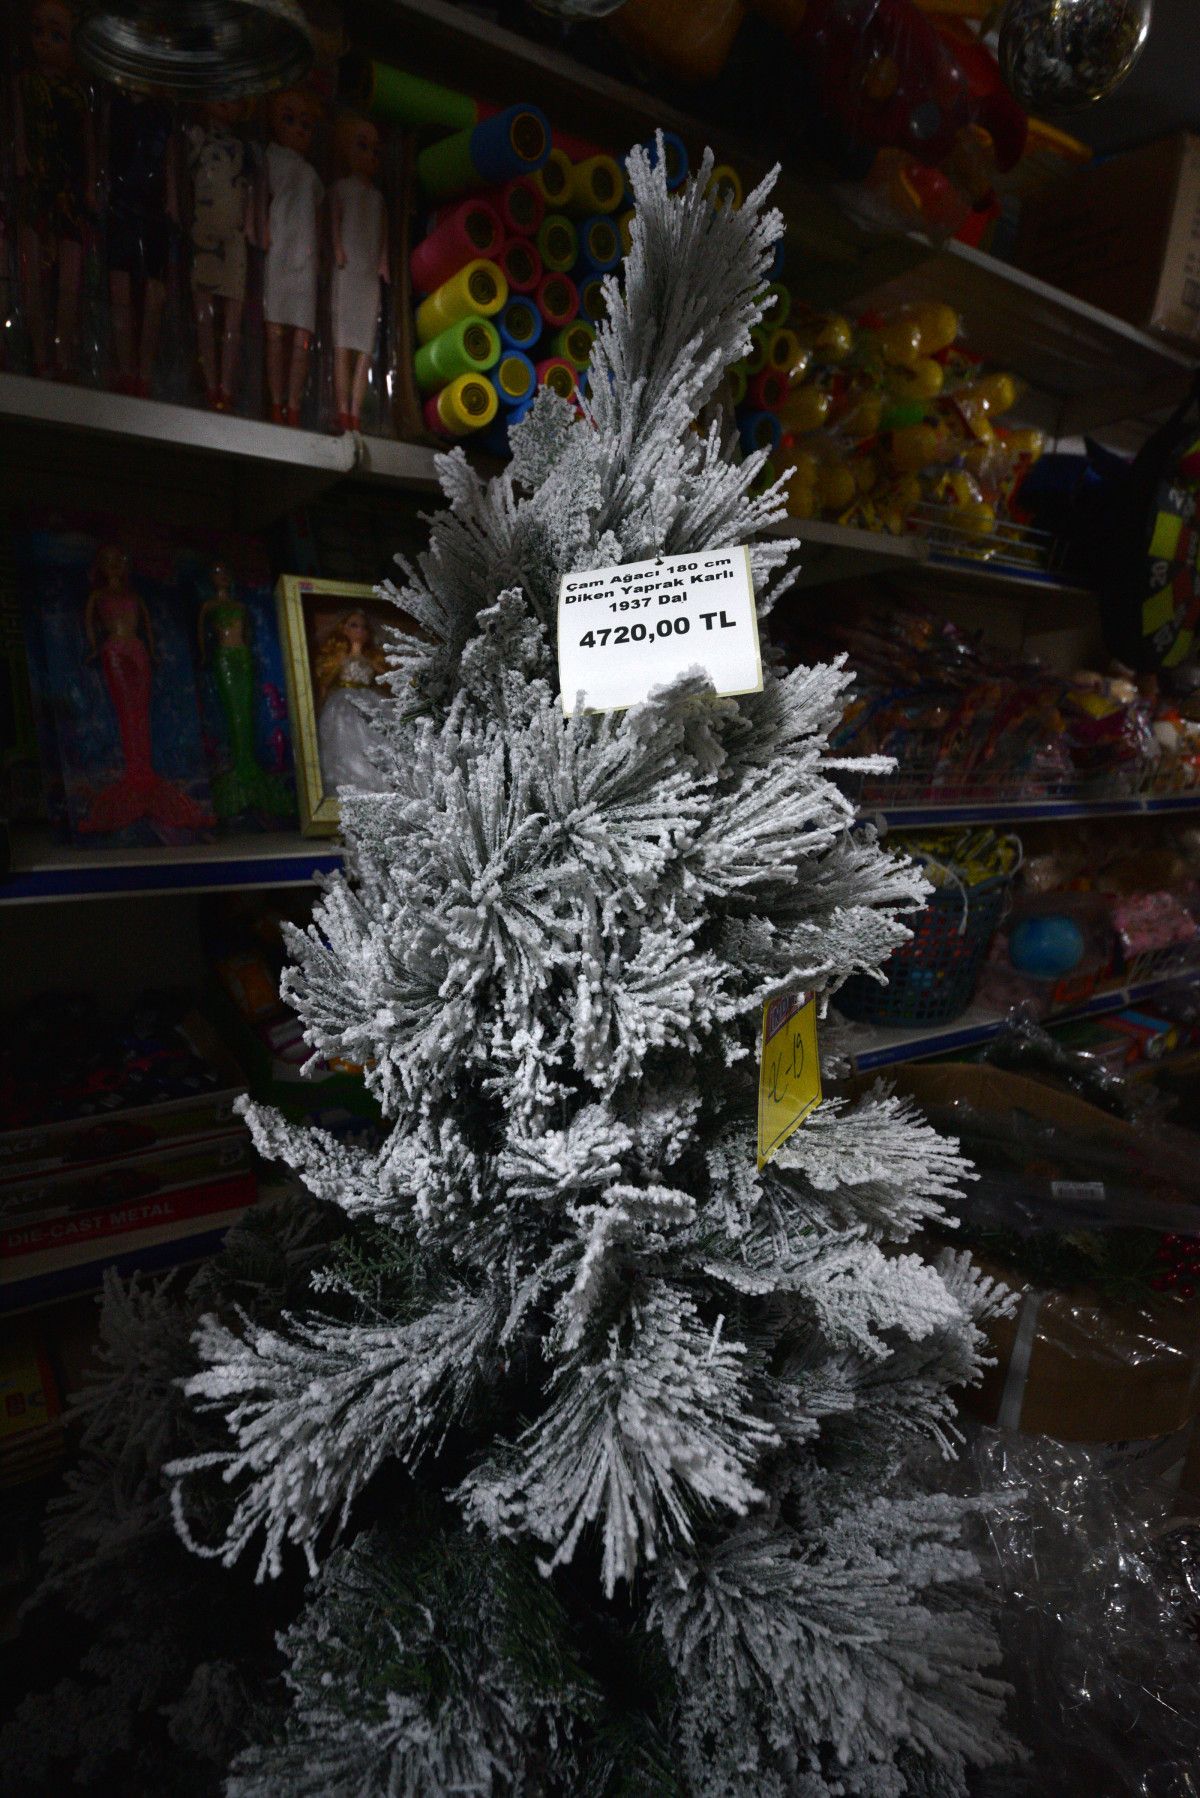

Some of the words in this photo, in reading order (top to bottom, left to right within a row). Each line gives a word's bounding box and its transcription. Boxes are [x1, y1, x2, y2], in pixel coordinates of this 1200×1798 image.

[565, 590, 615, 605] Diken
[621, 578, 684, 596] Yaprak
[691, 570, 734, 584] Karlı
[566, 578, 604, 592] Çam
[610, 570, 660, 584] Ağacı
[667, 562, 698, 574] 180
[704, 557, 732, 568] cm
[609, 598, 652, 612] 1937
[658, 591, 688, 606] Dal
[579, 616, 691, 649] 4720,00
[699, 610, 737, 631] TL
[7, 1214, 103, 1248] DIE-CAST
[109, 1202, 175, 1227] METAL
